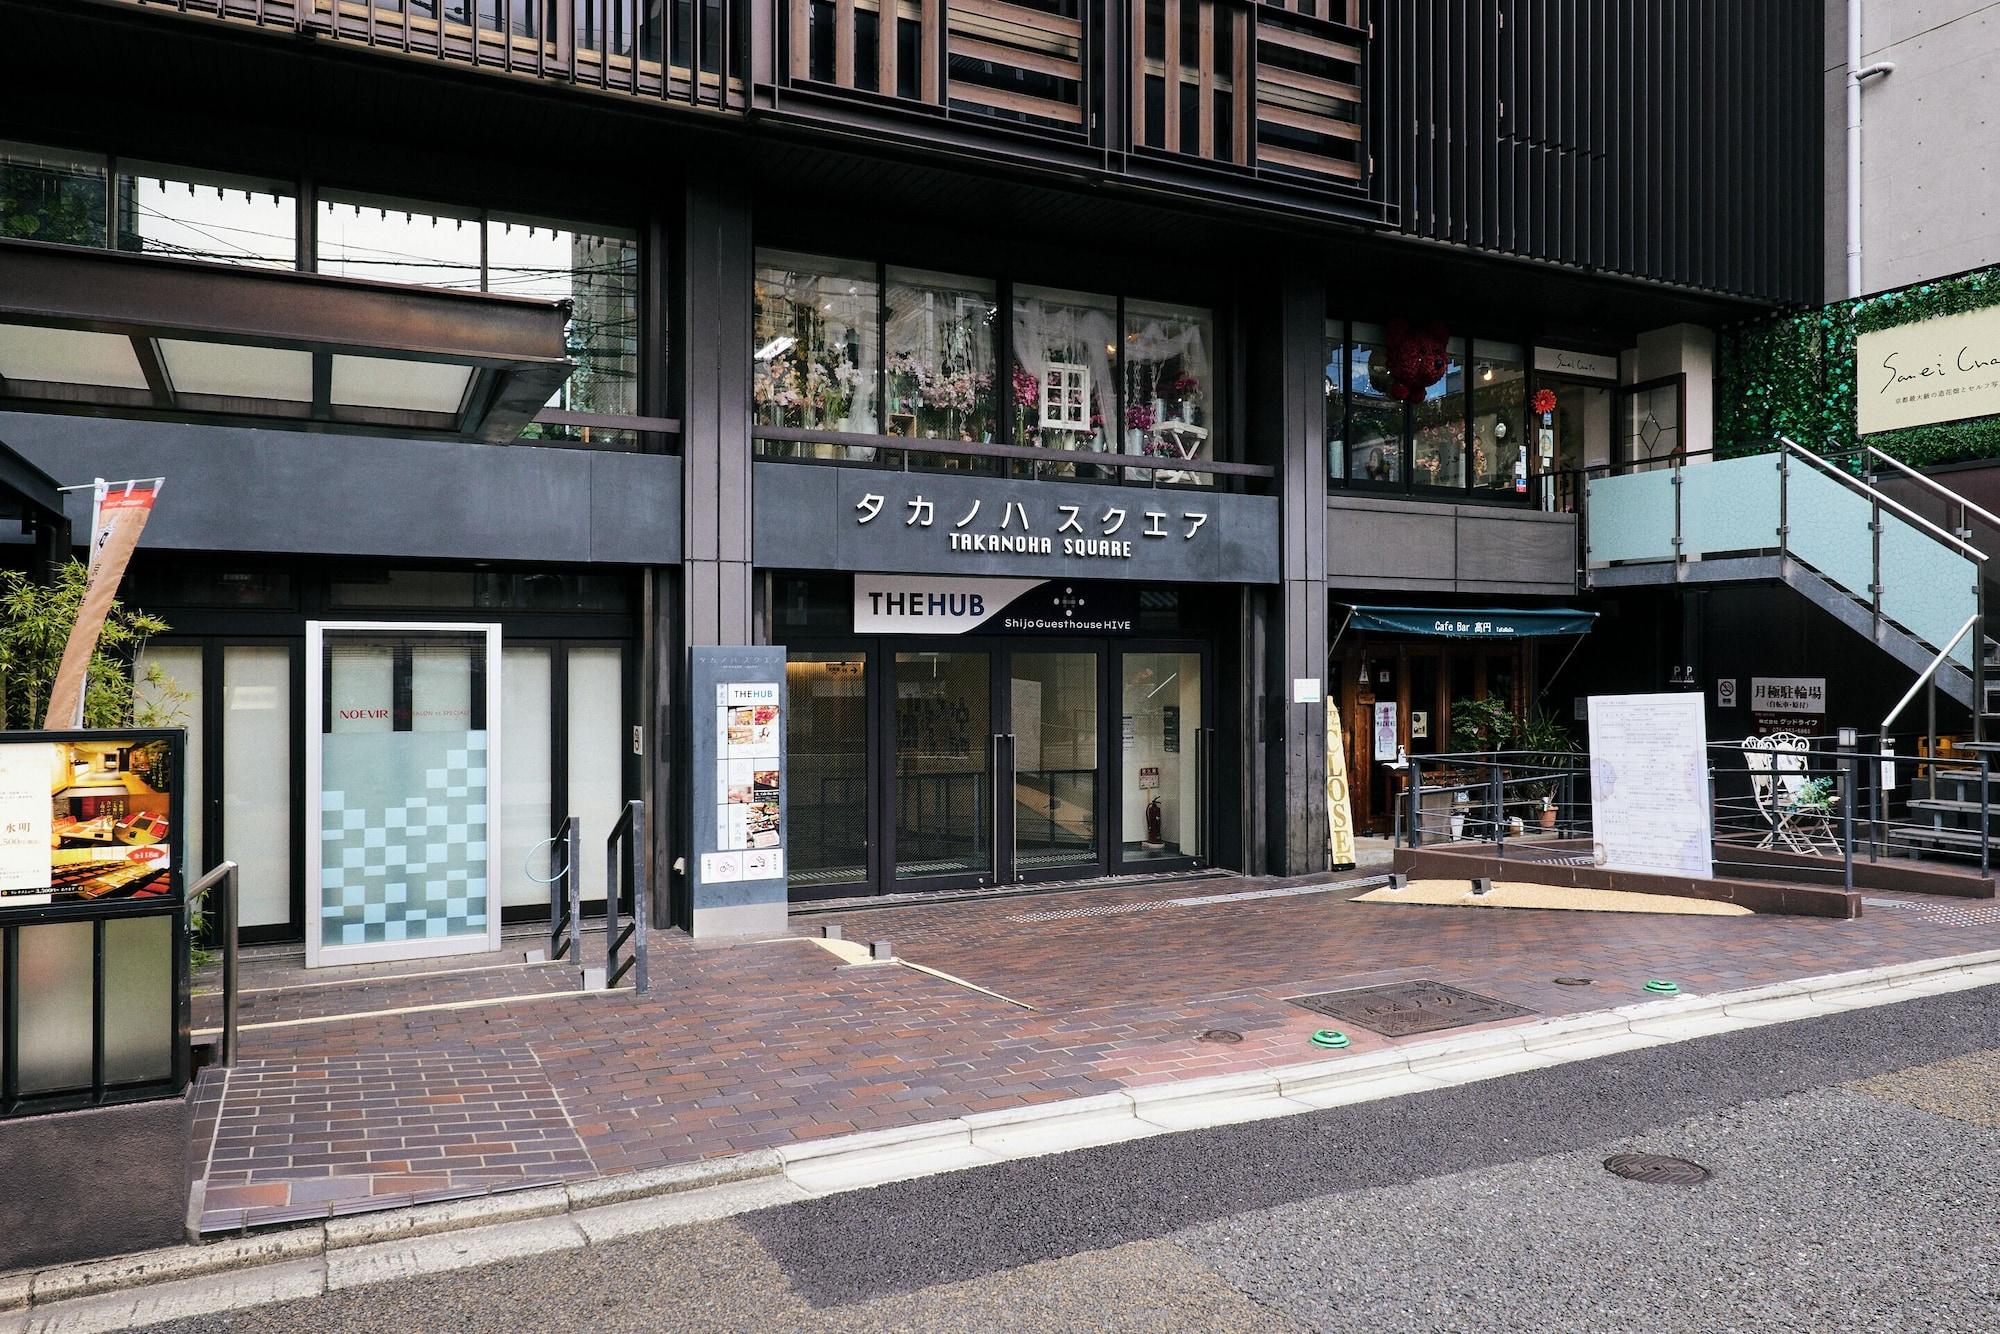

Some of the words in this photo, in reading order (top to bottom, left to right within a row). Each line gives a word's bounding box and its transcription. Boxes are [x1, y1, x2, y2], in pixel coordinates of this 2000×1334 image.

[949, 532, 1052, 554] TAKANOHA
[1064, 538, 1133, 558] SQUARE
[1434, 621, 1454, 632] Cafe
[1456, 621, 1471, 632] Bar
[1686, 665, 1693, 676] P
[1754, 685, 1822, 700] 月極駐輪場
[340, 709, 389, 719] NOEVIR
